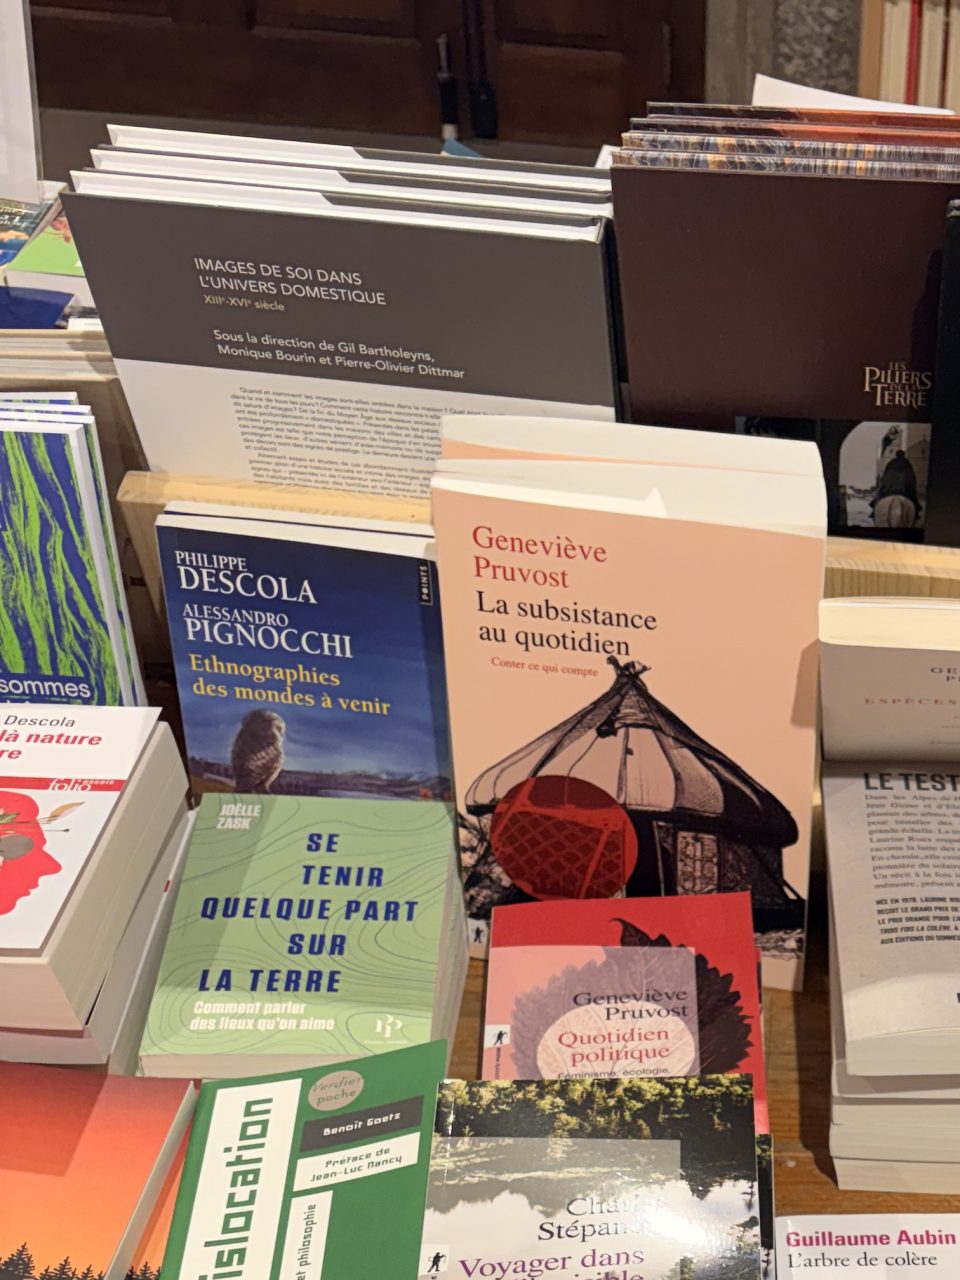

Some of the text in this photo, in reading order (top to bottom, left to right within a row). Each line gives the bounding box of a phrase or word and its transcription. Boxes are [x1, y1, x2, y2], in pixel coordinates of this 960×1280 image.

[195, 257, 362, 285] IMAGES SOI DANS
[199, 275, 387, 305] L'UNIVERS DOMESTIQUE
[213, 329, 435, 363] Sous direction Gil Bartholeyns,
[217, 344, 465, 379] Monique Bourin Pierre-Olivier Dittmar
[472, 526, 608, 563] Geneviève
[175, 550, 248, 571] PHILIPPE
[474, 556, 569, 589] Pruvost
[177, 565, 318, 604] DESCOLA
[183, 603, 288, 627] ALESSANDRO
[476, 591, 658, 630] La subsistance
[184, 617, 353, 658] PIGNOCCHI
[515, 630, 631, 657] quotidien
[189, 653, 341, 687] Ethnographies
[491, 656, 599, 678] Conter compte
[193, 677, 391, 716] des mondes venir
[3, 715, 76, 728] Descola
[26, 732, 103, 746] nature
[863, 772, 894, 791] LE
[897, 773, 960, 792] TEST
[220, 803, 261, 817] JOËLLE
[216, 817, 252, 830] ZASK
[307, 833, 340, 853] SE
[302, 865, 384, 888] TENIR
[200, 897, 419, 922] QUELQUE PART
[288, 933, 347, 956] SUR
[199, 969, 342, 993] LA TERRE
[573, 988, 689, 1007] Geneviève
[605, 1004, 689, 1021] Pruvost
[558, 1028, 670, 1048] Quotidien
[571, 1045, 671, 1067] politique
[786, 1229, 957, 1248] Guillaume Aubin
[458, 1249, 645, 1280] Voyager dans
[786, 1250, 938, 1268] L'arbre colère
